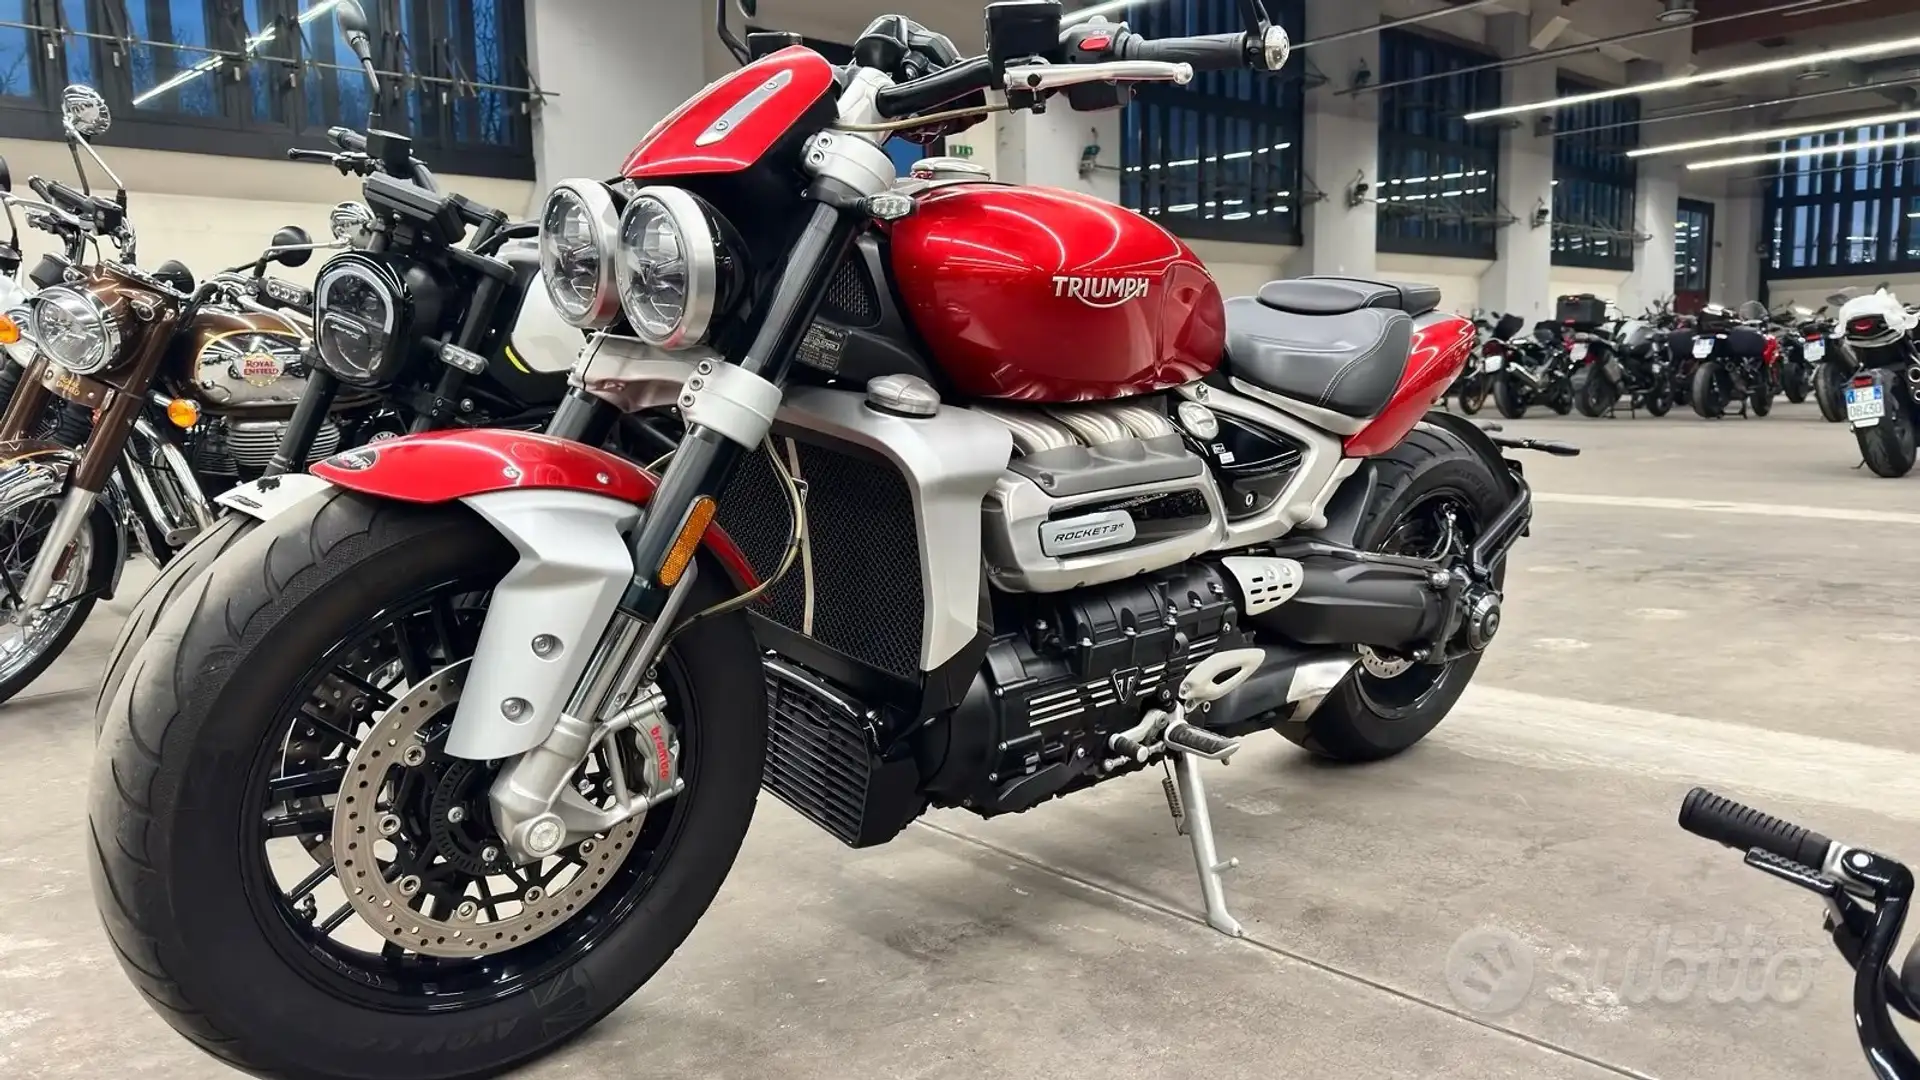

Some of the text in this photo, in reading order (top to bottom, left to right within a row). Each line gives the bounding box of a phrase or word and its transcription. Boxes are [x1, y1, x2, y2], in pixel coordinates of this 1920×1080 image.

[1052, 276, 1149, 308] TRIUMPH
[243, 368, 279, 376] ENFIELD
[651, 725, 670, 779] brembo
